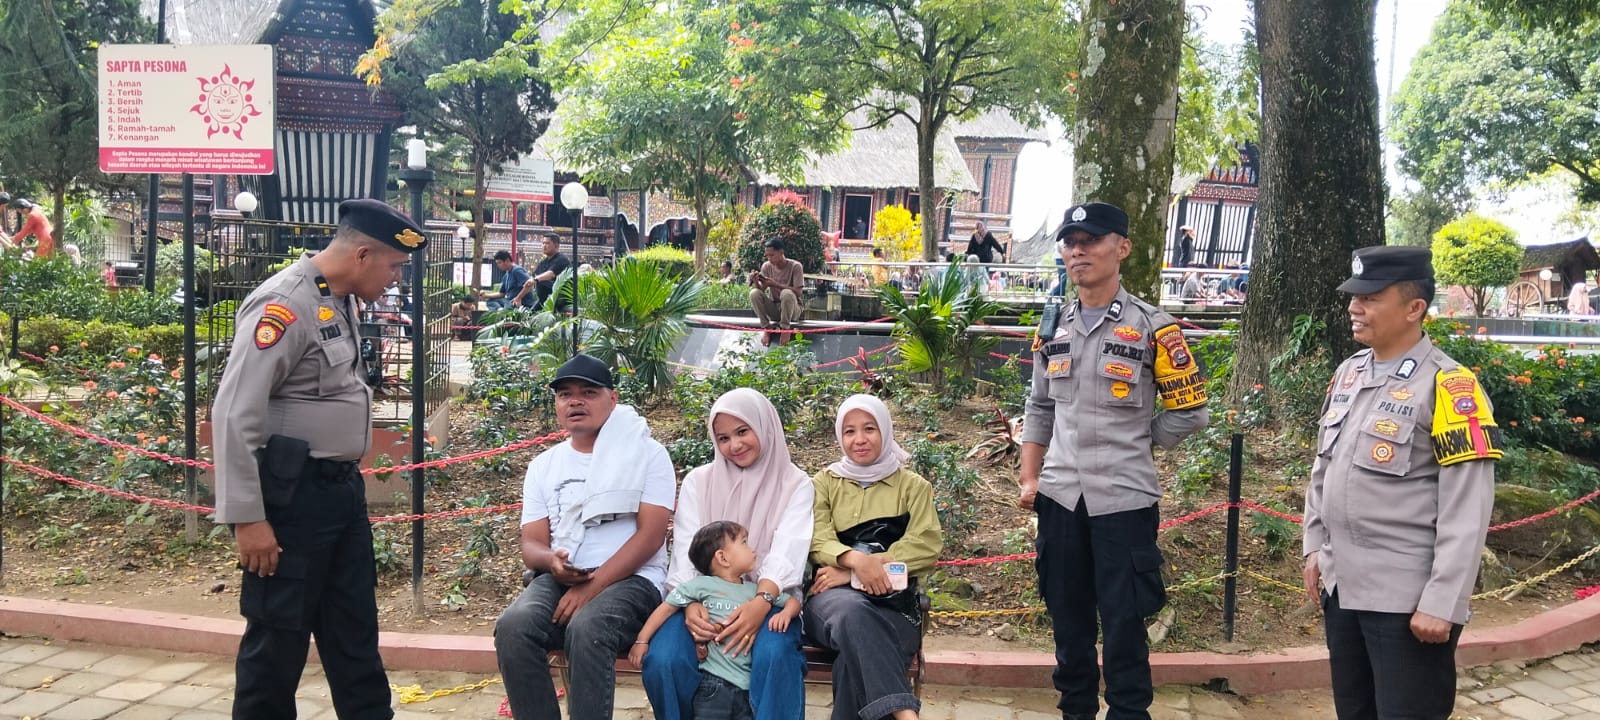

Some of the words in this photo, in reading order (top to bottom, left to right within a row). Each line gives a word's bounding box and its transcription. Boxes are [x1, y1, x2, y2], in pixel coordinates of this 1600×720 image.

[106, 60, 141, 73] SAPTA
[143, 60, 187, 73] PESONA
[117, 107, 140, 115] Sejuk
[117, 134, 159, 142] Kenangan
[1102, 342, 1144, 361] POLRI
[1377, 401, 1415, 417] POLISI
